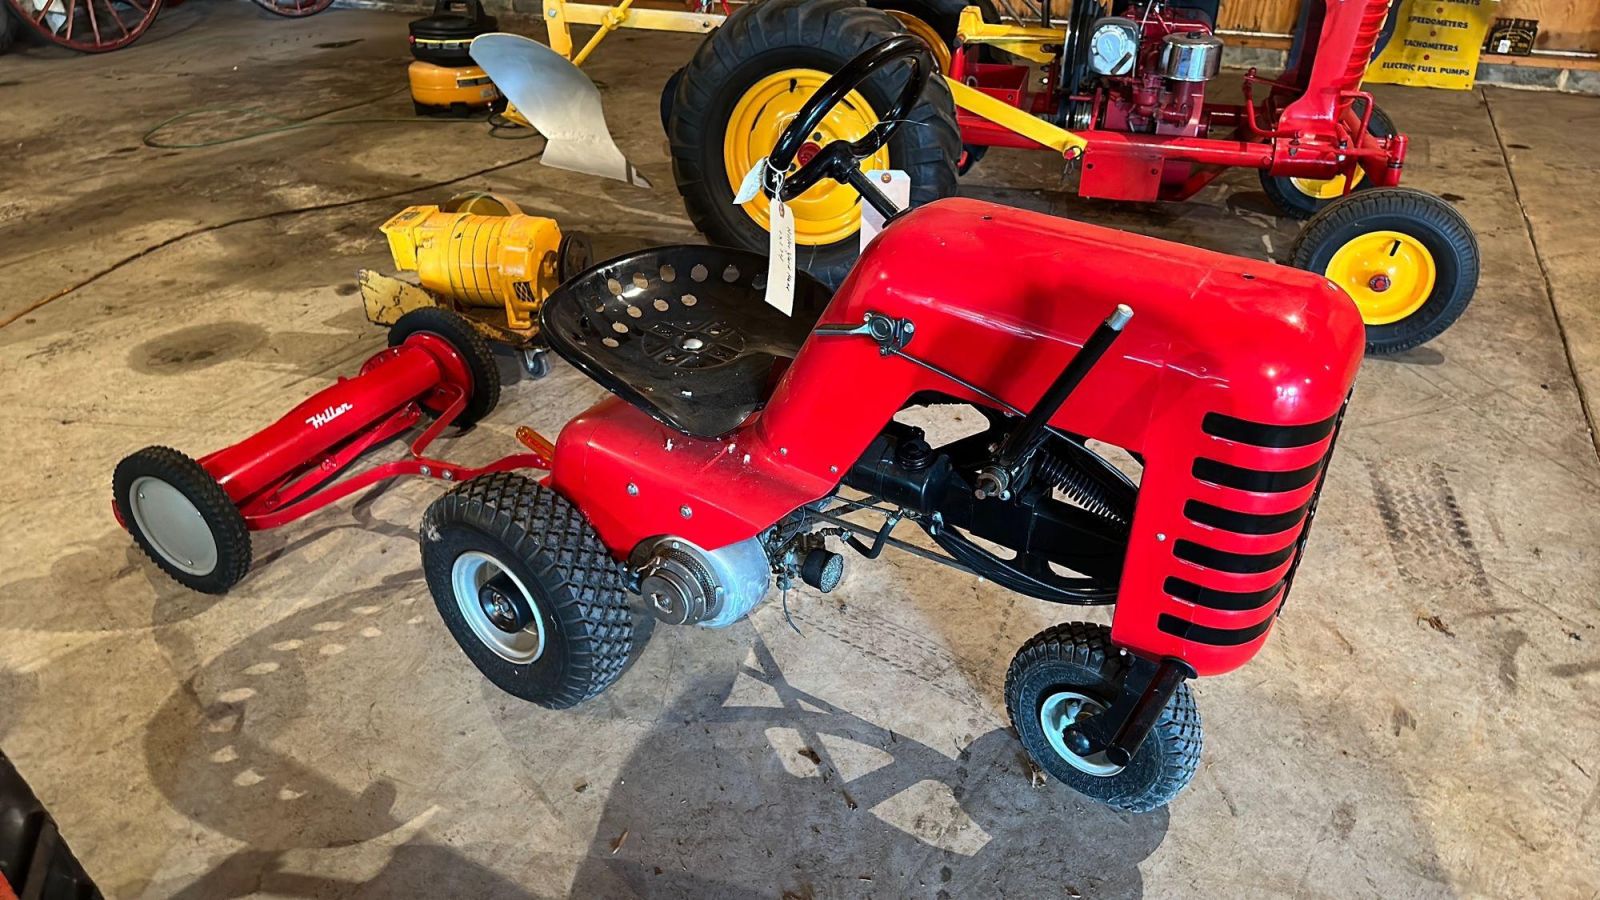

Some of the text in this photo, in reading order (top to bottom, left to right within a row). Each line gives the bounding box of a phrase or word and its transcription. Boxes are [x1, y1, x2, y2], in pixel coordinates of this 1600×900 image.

[1407, 16, 1468, 29] SPEEDOMETERS
[1404, 39, 1458, 52] TACHOMETERS
[1382, 62, 1470, 76] ELECTRIC FUEL PUMPS
[305, 402, 353, 429] Hiller
